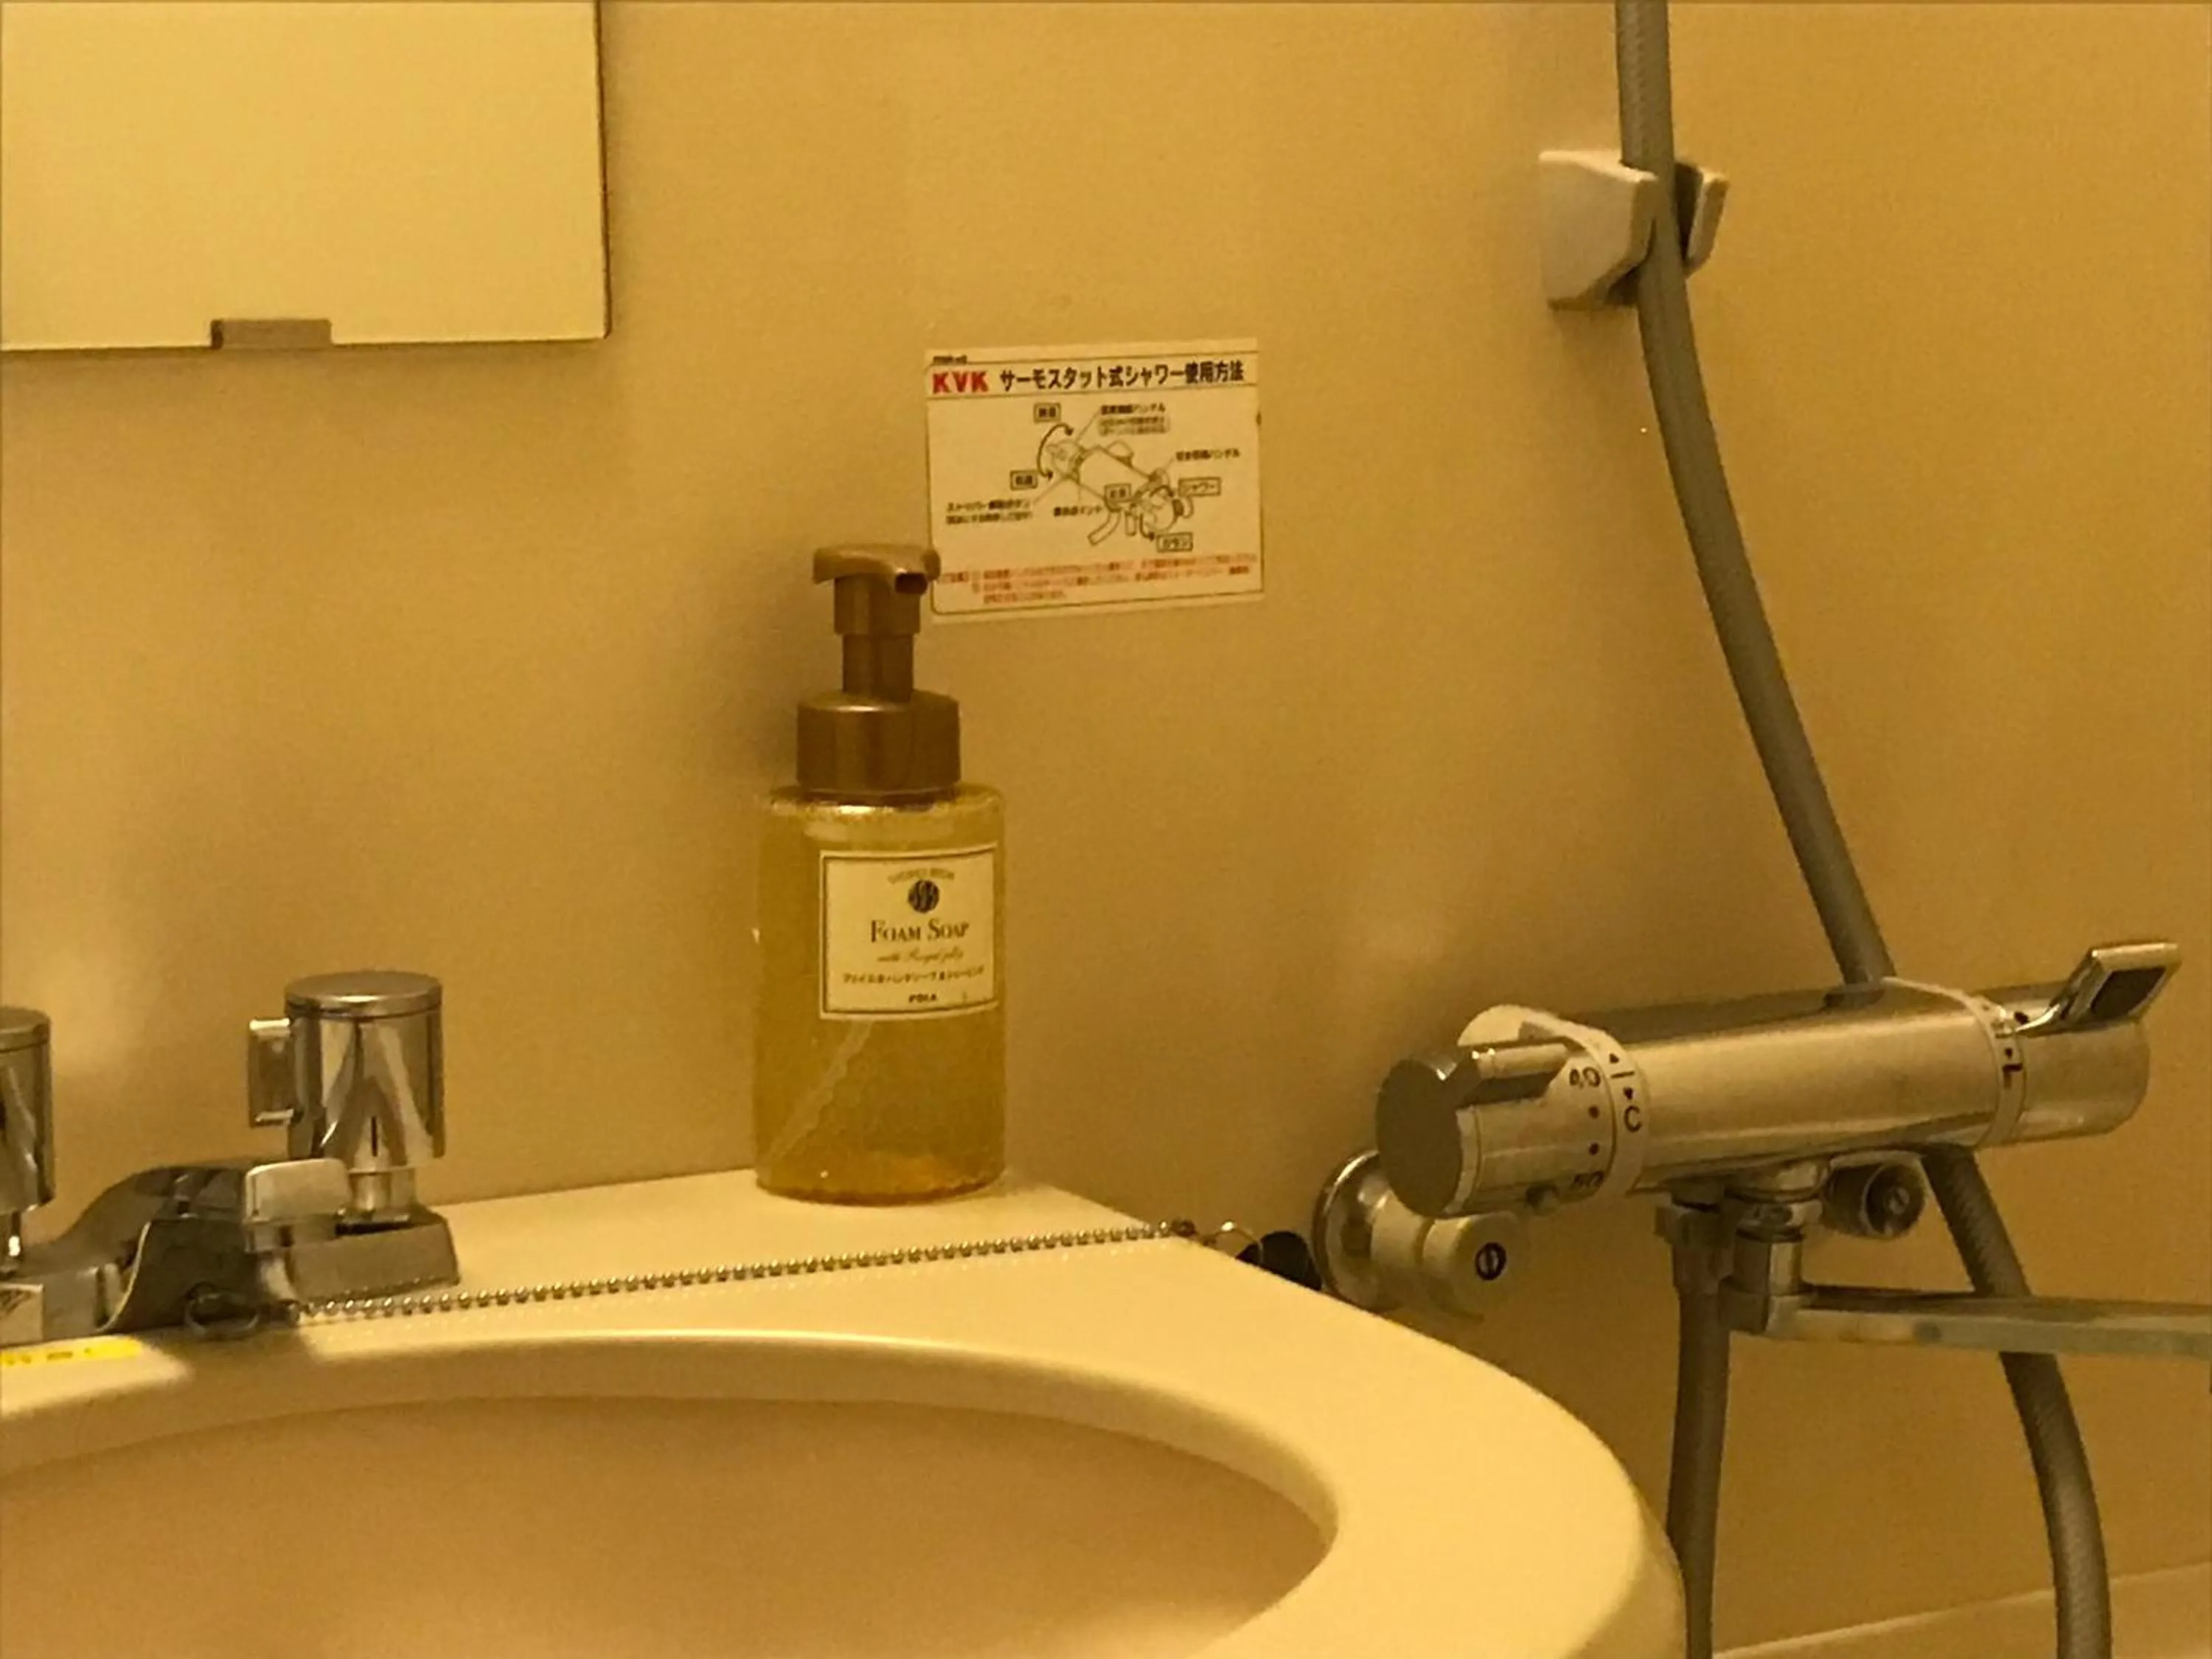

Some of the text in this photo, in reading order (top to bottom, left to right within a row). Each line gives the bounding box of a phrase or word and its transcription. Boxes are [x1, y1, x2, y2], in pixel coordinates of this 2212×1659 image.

[932, 359, 1245, 394] KVK サーモスタット式シャワー使用方法
